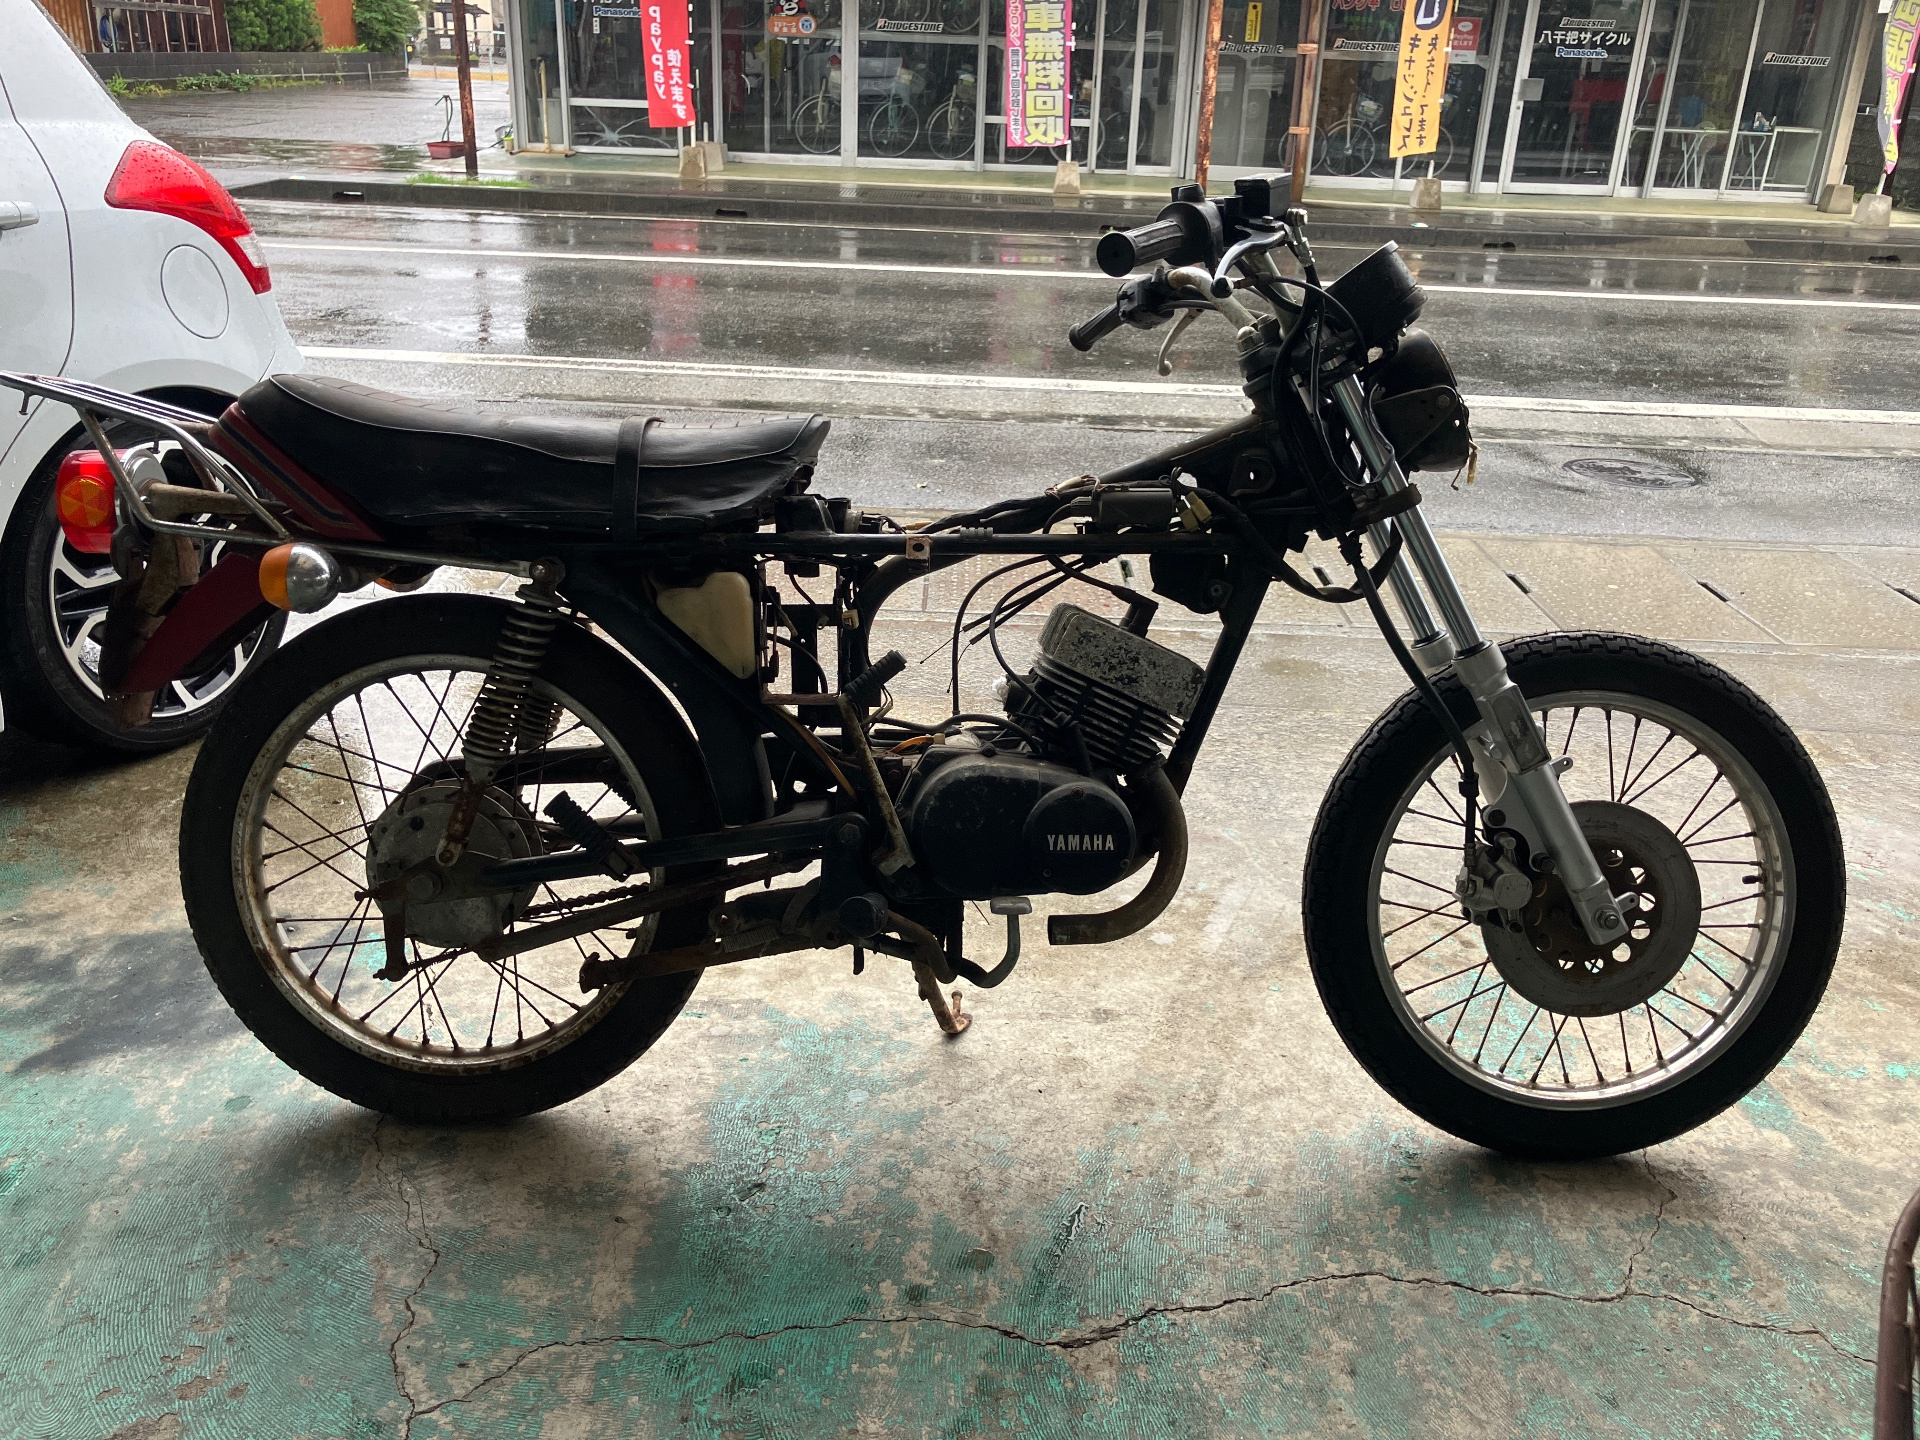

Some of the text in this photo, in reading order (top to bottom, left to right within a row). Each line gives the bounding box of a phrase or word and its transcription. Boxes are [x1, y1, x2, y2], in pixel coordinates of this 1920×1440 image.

[593, 6, 642, 17] Panasonic
[876, 19, 943, 32] BRIDGESTONE
[1559, 17, 1616, 28] BRIDGESTONE
[1218, 41, 1284, 53] BRIDGESTONE
[1334, 38, 1400, 51] BRIDGESTONE
[1556, 46, 1608, 58] Panasonic
[1763, 52, 1831, 66] BRIDGESTONE
[1047, 835, 1114, 850] YAMAHA
